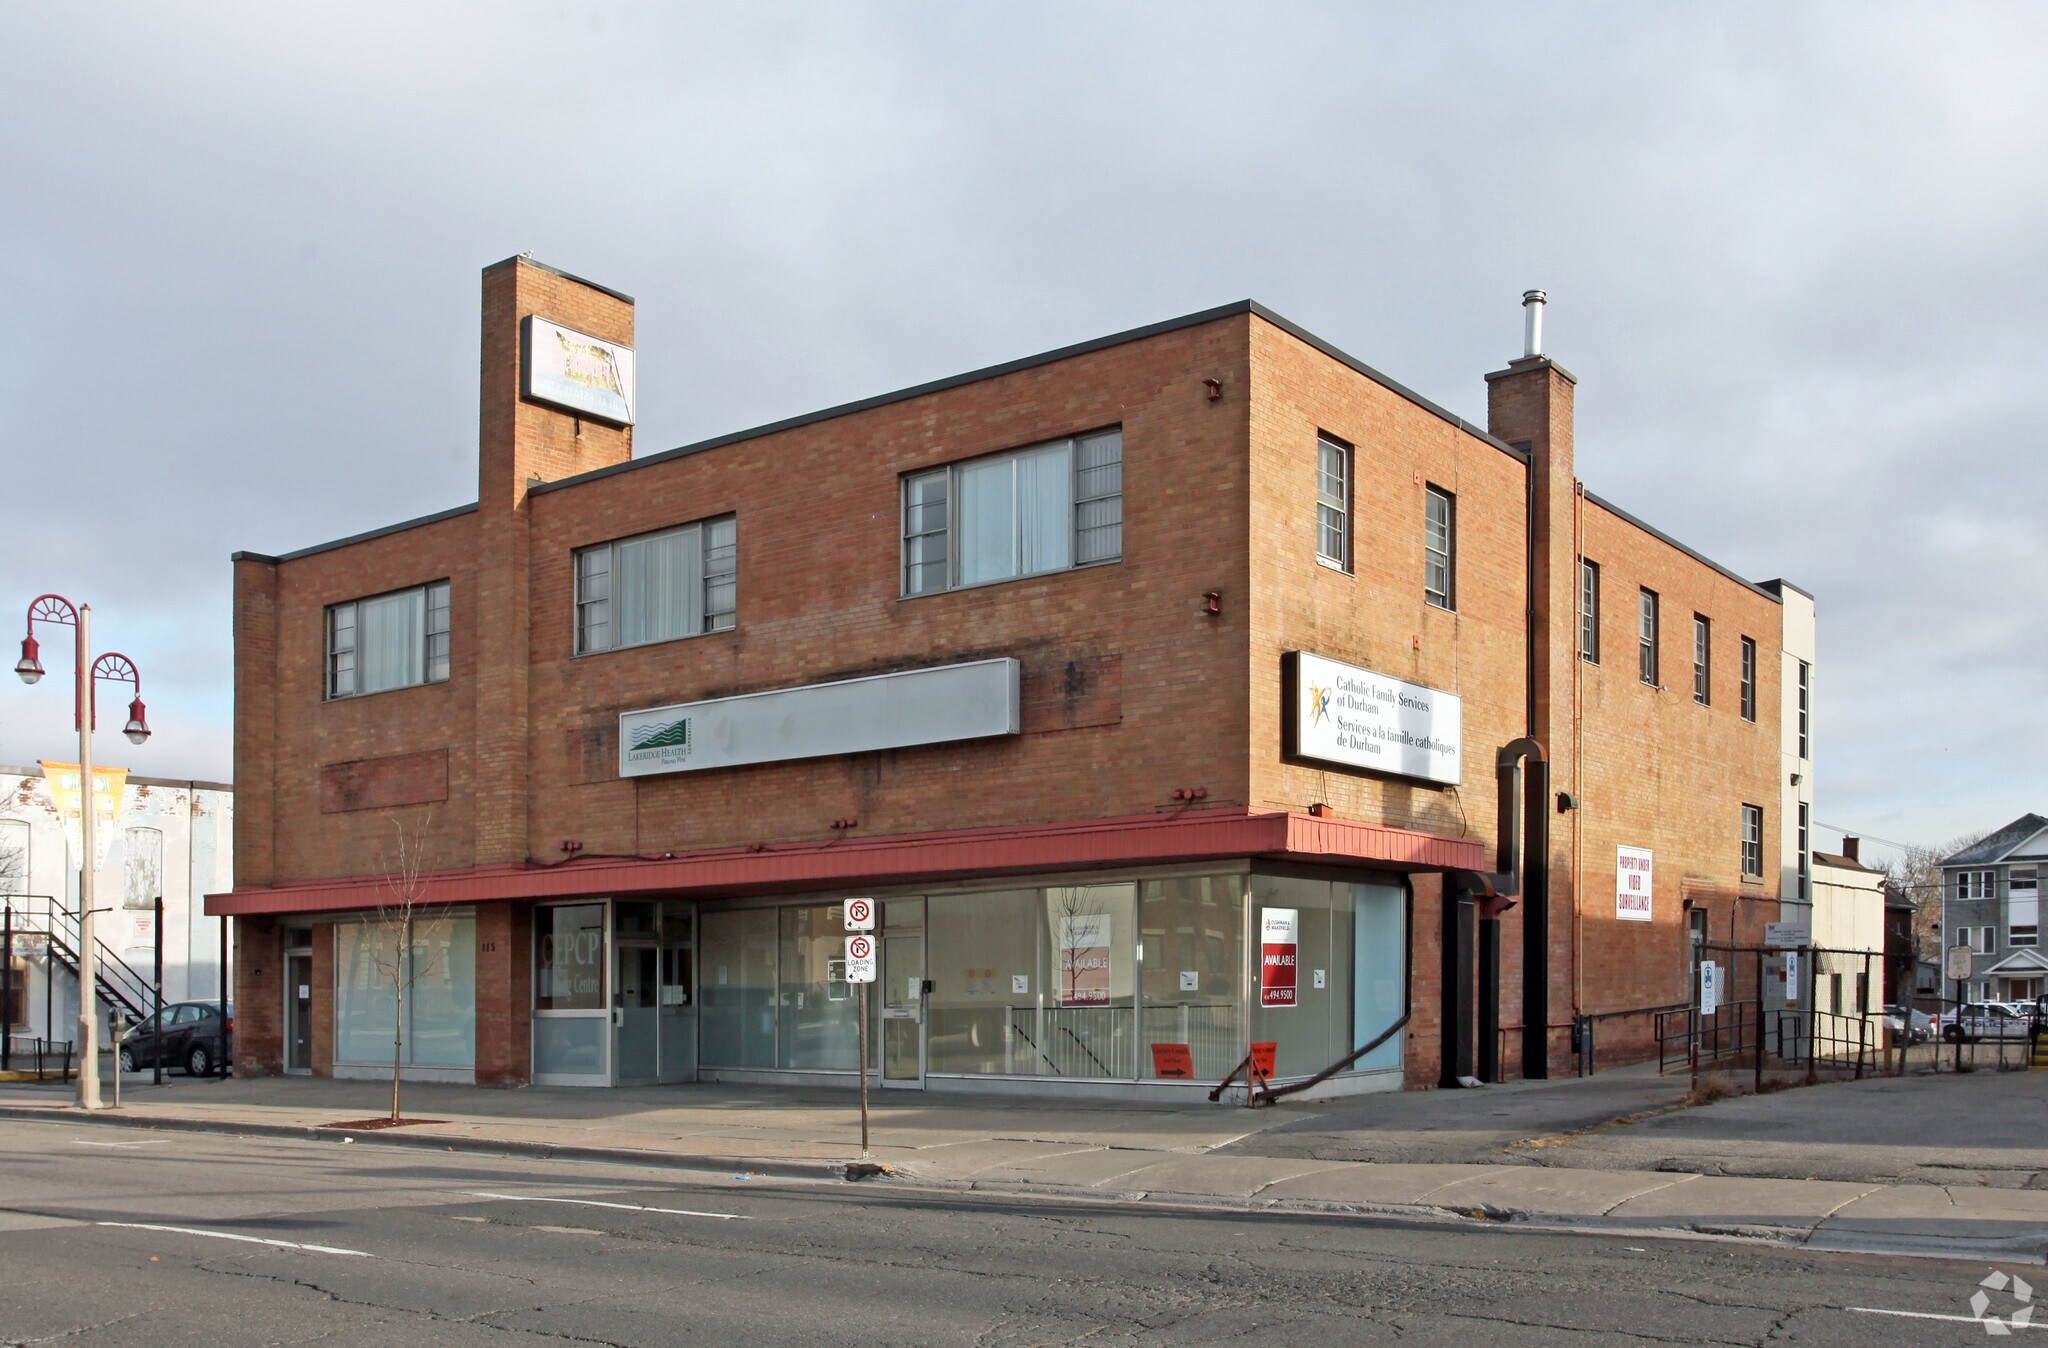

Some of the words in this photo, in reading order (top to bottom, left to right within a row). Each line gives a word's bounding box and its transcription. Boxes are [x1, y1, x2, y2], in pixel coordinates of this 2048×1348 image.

[1337, 676, 1370, 696] Catholic
[1372, 685, 1397, 708] Family
[1398, 694, 1430, 712] Services
[1337, 693, 1346, 707] of
[1347, 695, 1379, 715] Durham
[1337, 716, 1371, 737] Services
[1378, 725, 1386, 740] la
[1387, 727, 1414, 746] famille
[1415, 732, 1456, 757] catholiques
[1337, 731, 1348, 747] de
[1349, 734, 1381, 755] Durham
[1619, 856, 1638, 870] PROPERTY
[1638, 858, 1650, 871] UNDER
[1628, 874, 1641, 890] VIDEO
[1619, 893, 1649, 911] SURVEILLANCE
[482, 943, 495, 952] 115
[847, 958, 874, 966] LOADING
[1065, 958, 1108, 968] AVAILABLE
[1264, 955, 1295, 965] AVAILABLE
[574, 974, 600, 993] Centre
